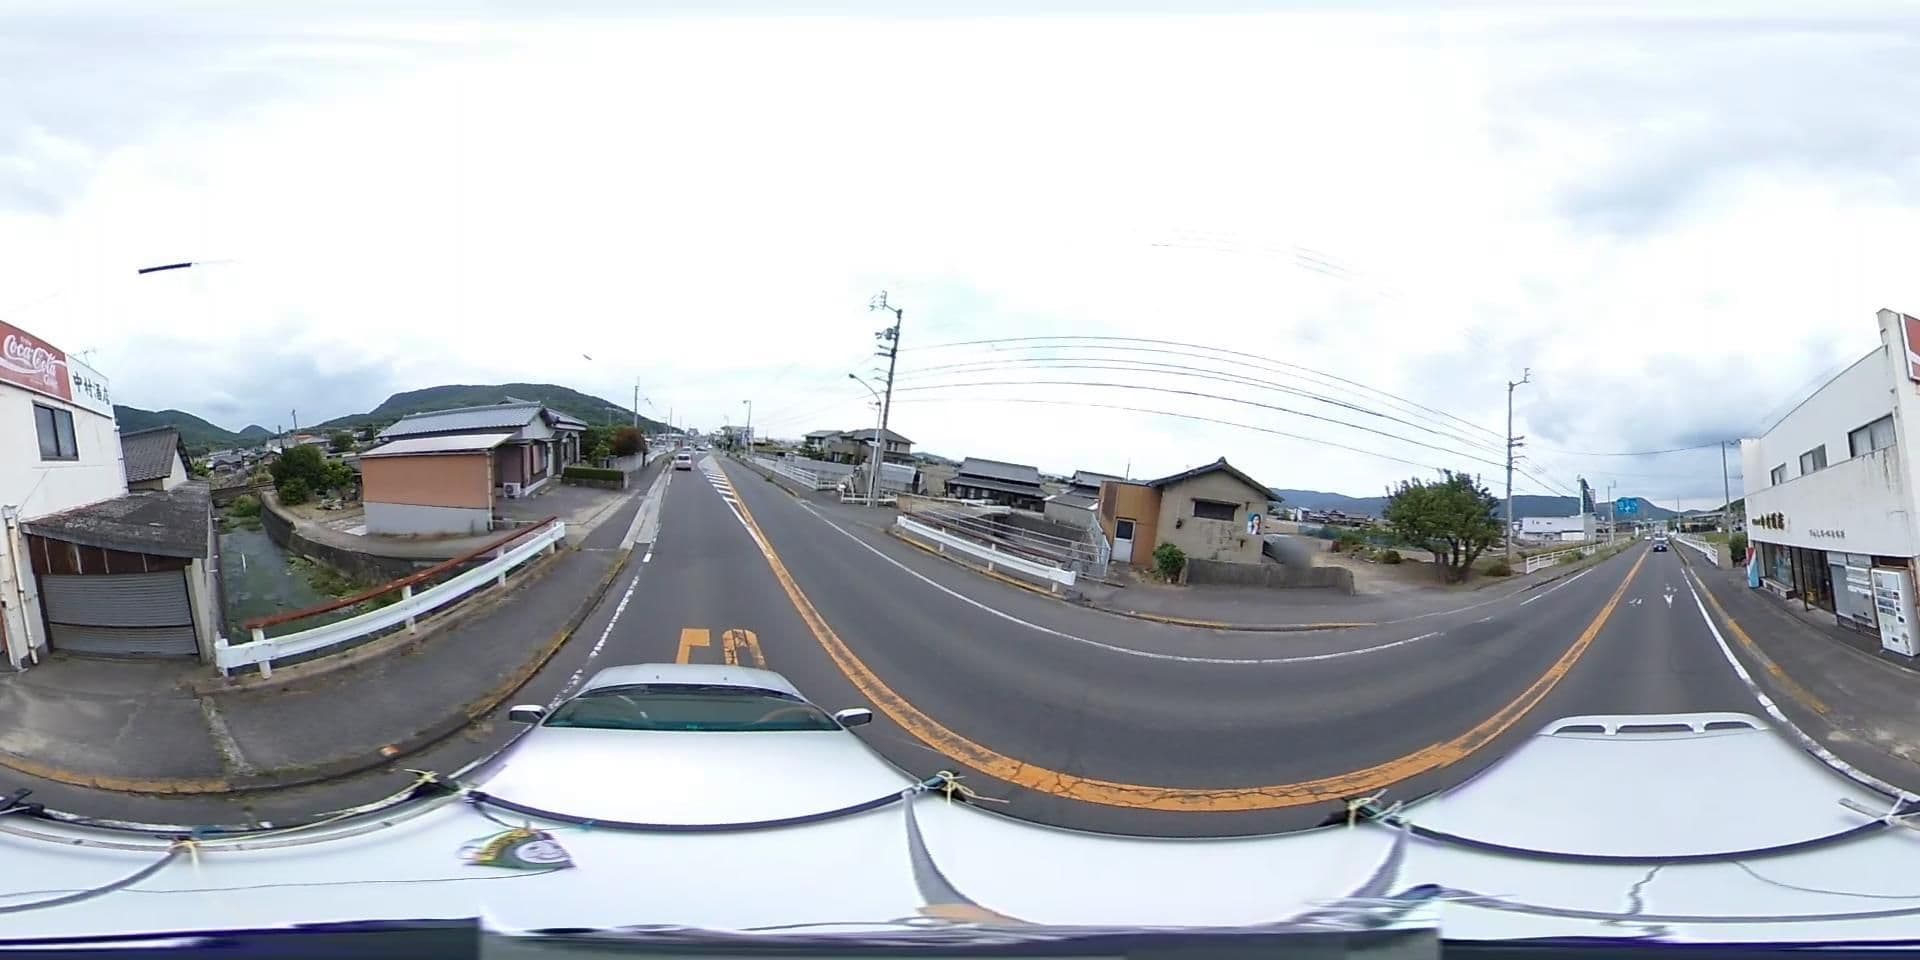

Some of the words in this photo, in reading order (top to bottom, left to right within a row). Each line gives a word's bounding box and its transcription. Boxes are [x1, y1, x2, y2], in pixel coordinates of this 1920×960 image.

[3, 334, 58, 377] Coca-Cola
[73, 371, 110, 405] 中村酒店
